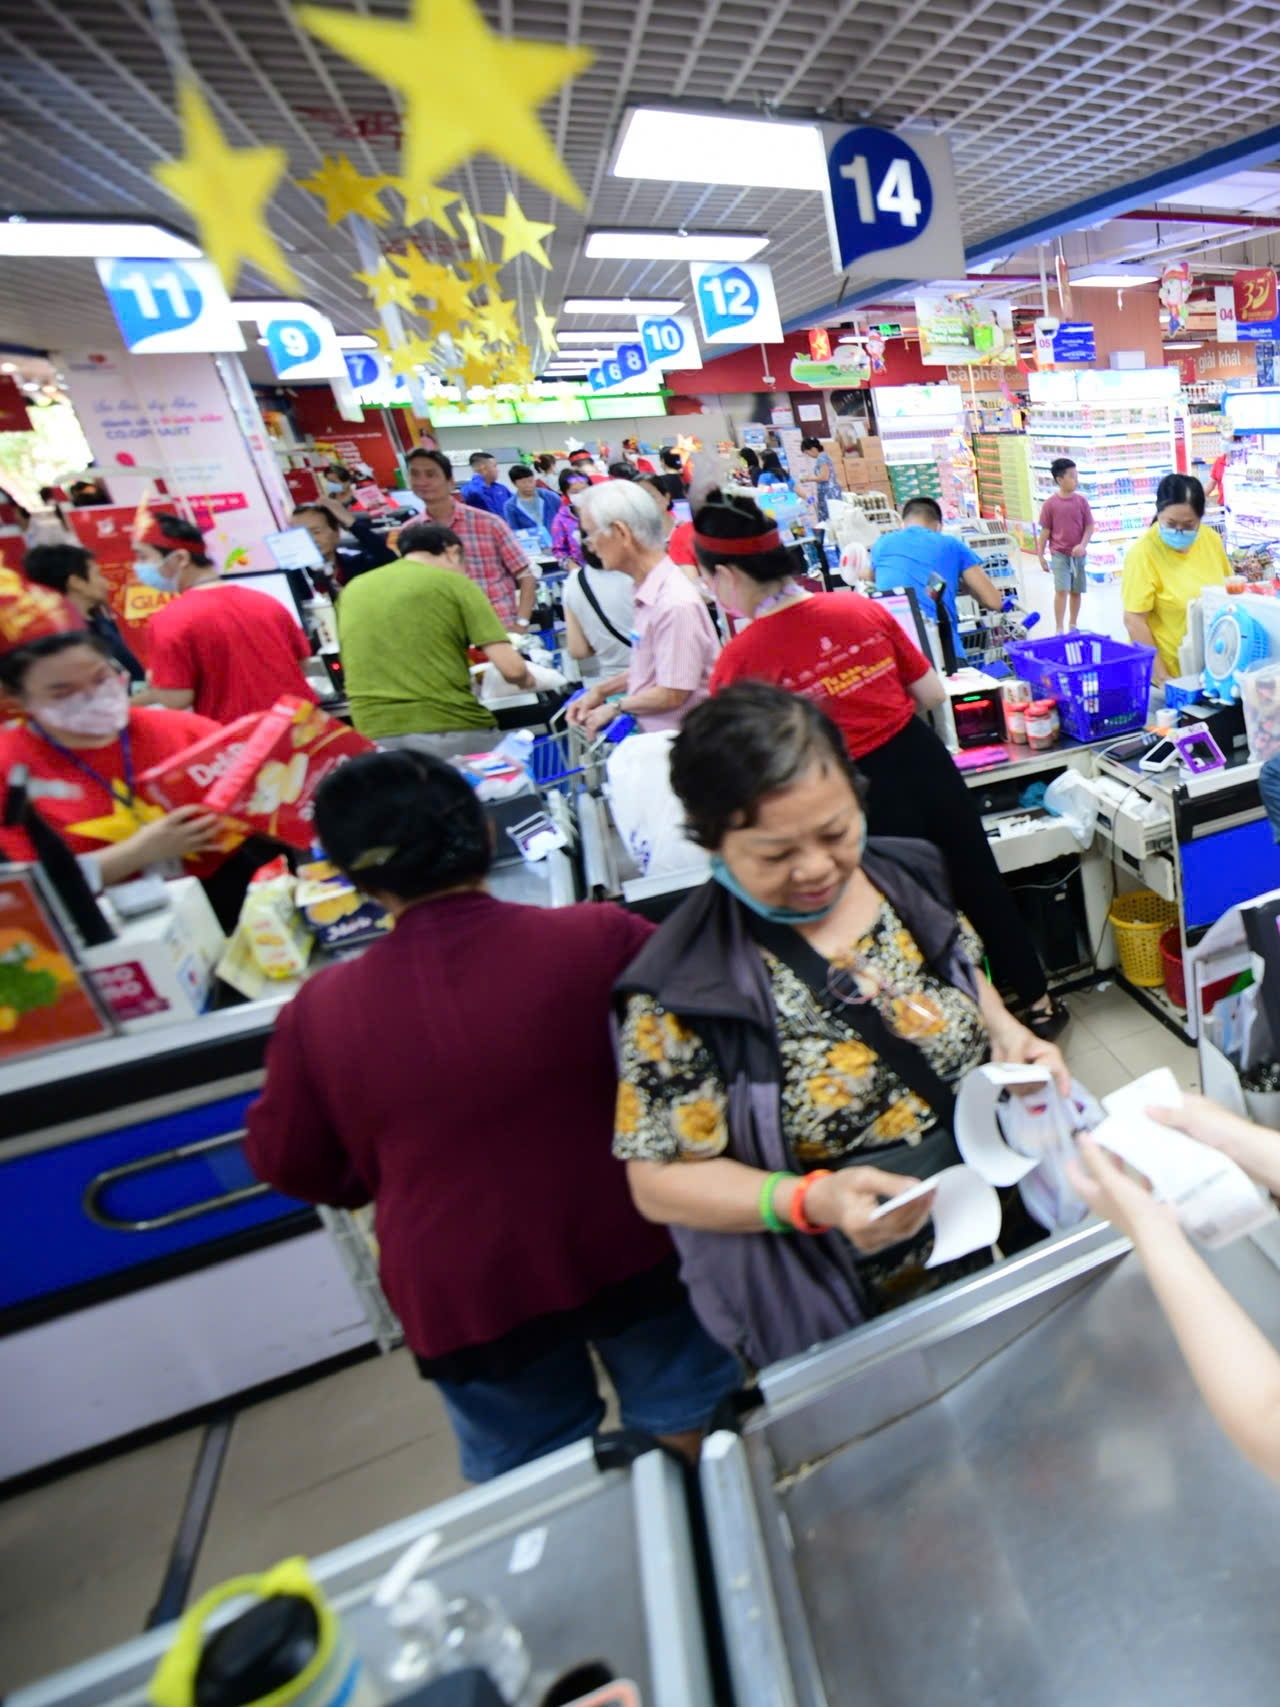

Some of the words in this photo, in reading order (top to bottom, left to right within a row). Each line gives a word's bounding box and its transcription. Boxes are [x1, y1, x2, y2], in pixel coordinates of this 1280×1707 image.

[839, 155, 922, 227] 14
[118, 270, 190, 319] 11
[703, 277, 755, 316] 12
[1219, 308, 1234, 321] 04
[280, 328, 309, 358] 9
[645, 325, 681, 351] 10
[1039, 339, 1051, 348] 05
[349, 359, 367, 380] 7
[625, 351, 642, 371] 8
[608, 363, 622, 381] 6
[949, 366, 969, 382] cà
